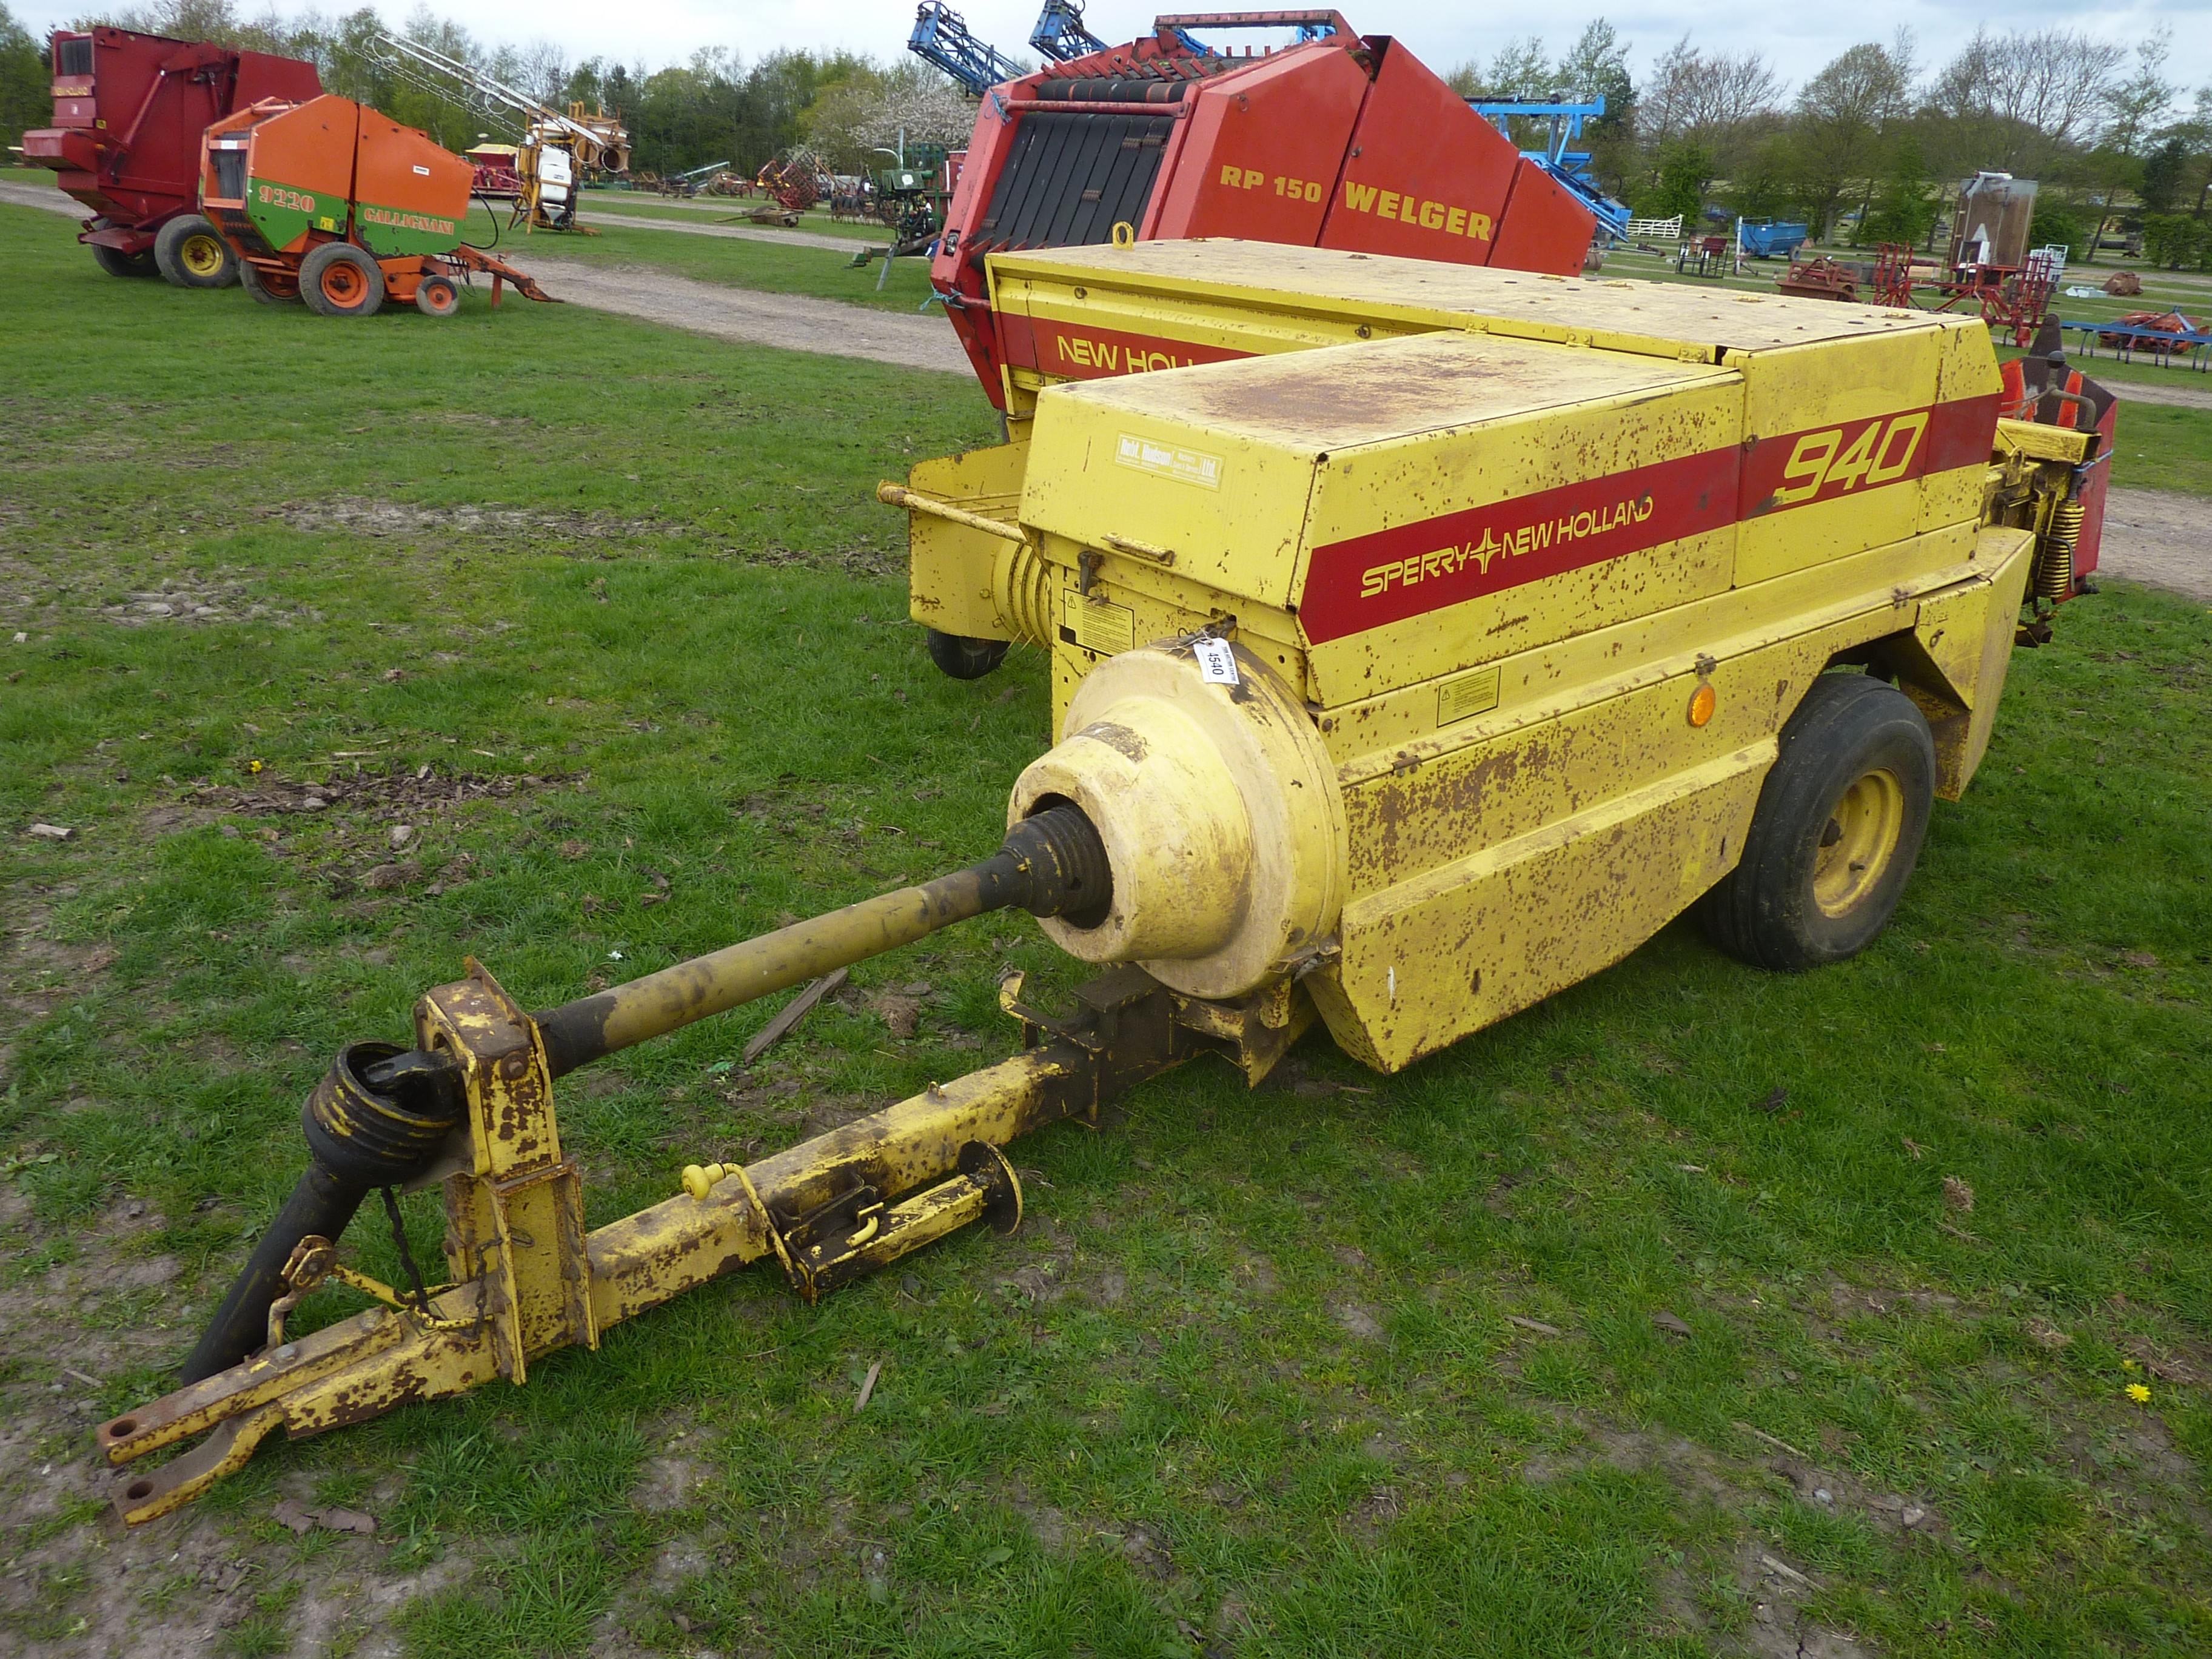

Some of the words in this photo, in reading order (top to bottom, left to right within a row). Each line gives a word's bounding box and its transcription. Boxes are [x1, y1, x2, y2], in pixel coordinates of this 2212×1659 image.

[259, 185, 315, 213] 9220
[1220, 165, 1264, 190] RP
[1273, 176, 1322, 203] 150
[364, 207, 454, 235] GALLIGNANI
[1345, 181, 1492, 241] WELGER
[1057, 335, 1118, 370] NEW
[1141, 443, 1171, 466] Hudson
[1772, 411, 1929, 507] 940
[1360, 541, 1472, 598] SPERRY
[1501, 520, 1554, 559] NEW
[1557, 495, 1654, 544] HOLLAND
[1207, 652, 1224, 675] 4540
